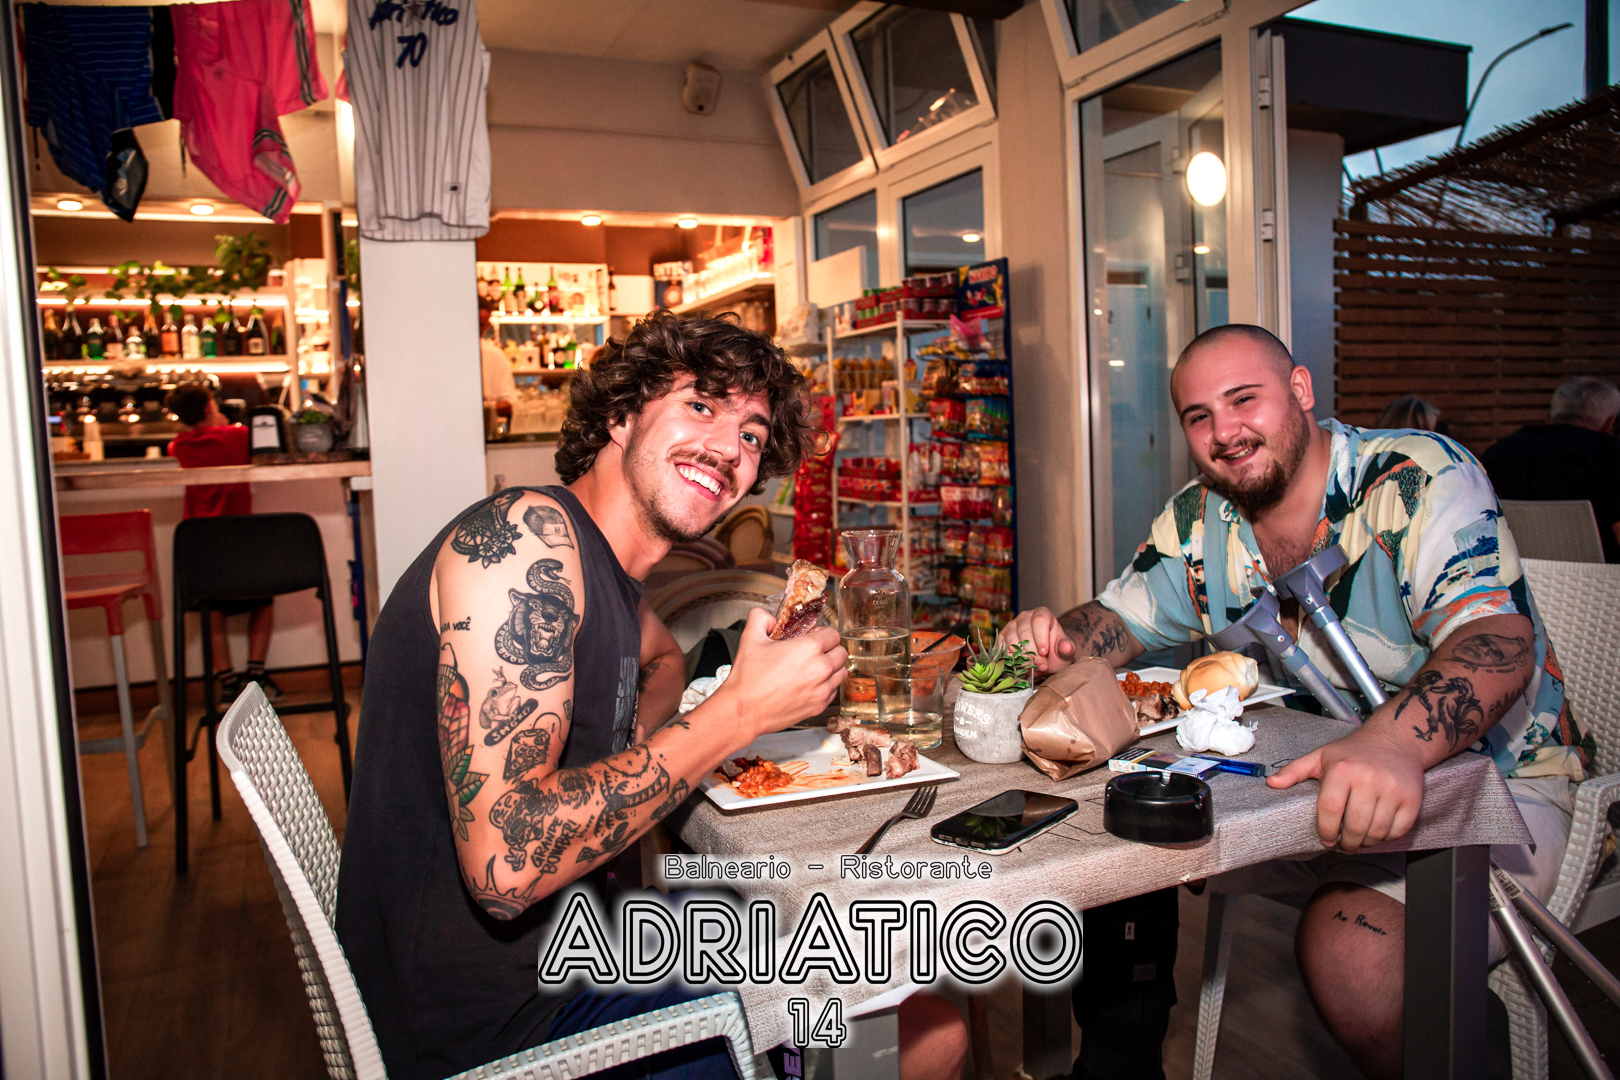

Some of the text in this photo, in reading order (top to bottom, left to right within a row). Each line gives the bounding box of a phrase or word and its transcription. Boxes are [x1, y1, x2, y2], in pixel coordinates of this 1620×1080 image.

[396, 32, 427, 69] 70
[452, 615, 472, 631] VOCÊ
[531, 816, 563, 868] GRANDE
